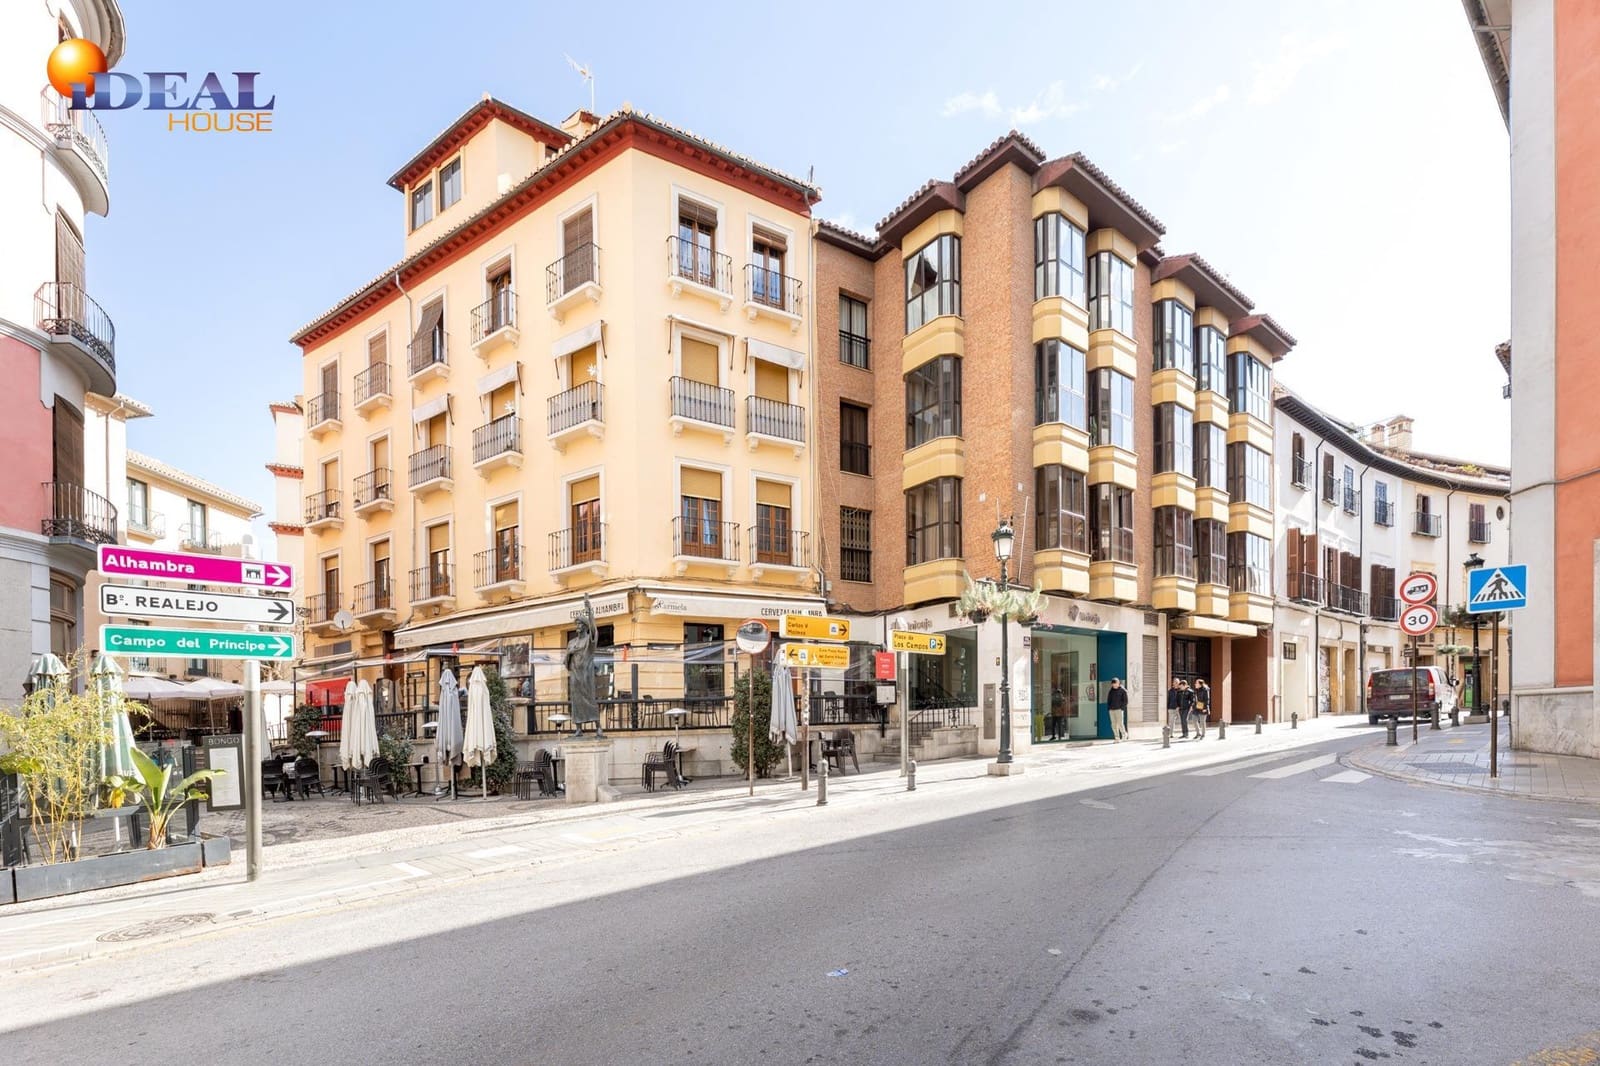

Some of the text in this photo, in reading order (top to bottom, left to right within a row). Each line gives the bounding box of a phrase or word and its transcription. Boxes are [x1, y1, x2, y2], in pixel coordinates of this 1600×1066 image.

[105, 554, 195, 574] Alhambra
[136, 596, 219, 612] REALEJO
[1407, 614, 1429, 626] 30
[110, 634, 166, 649] Campo
[176, 637, 200, 648] del
[906, 641, 928, 650] Campos
[208, 737, 240, 746] BONGO
